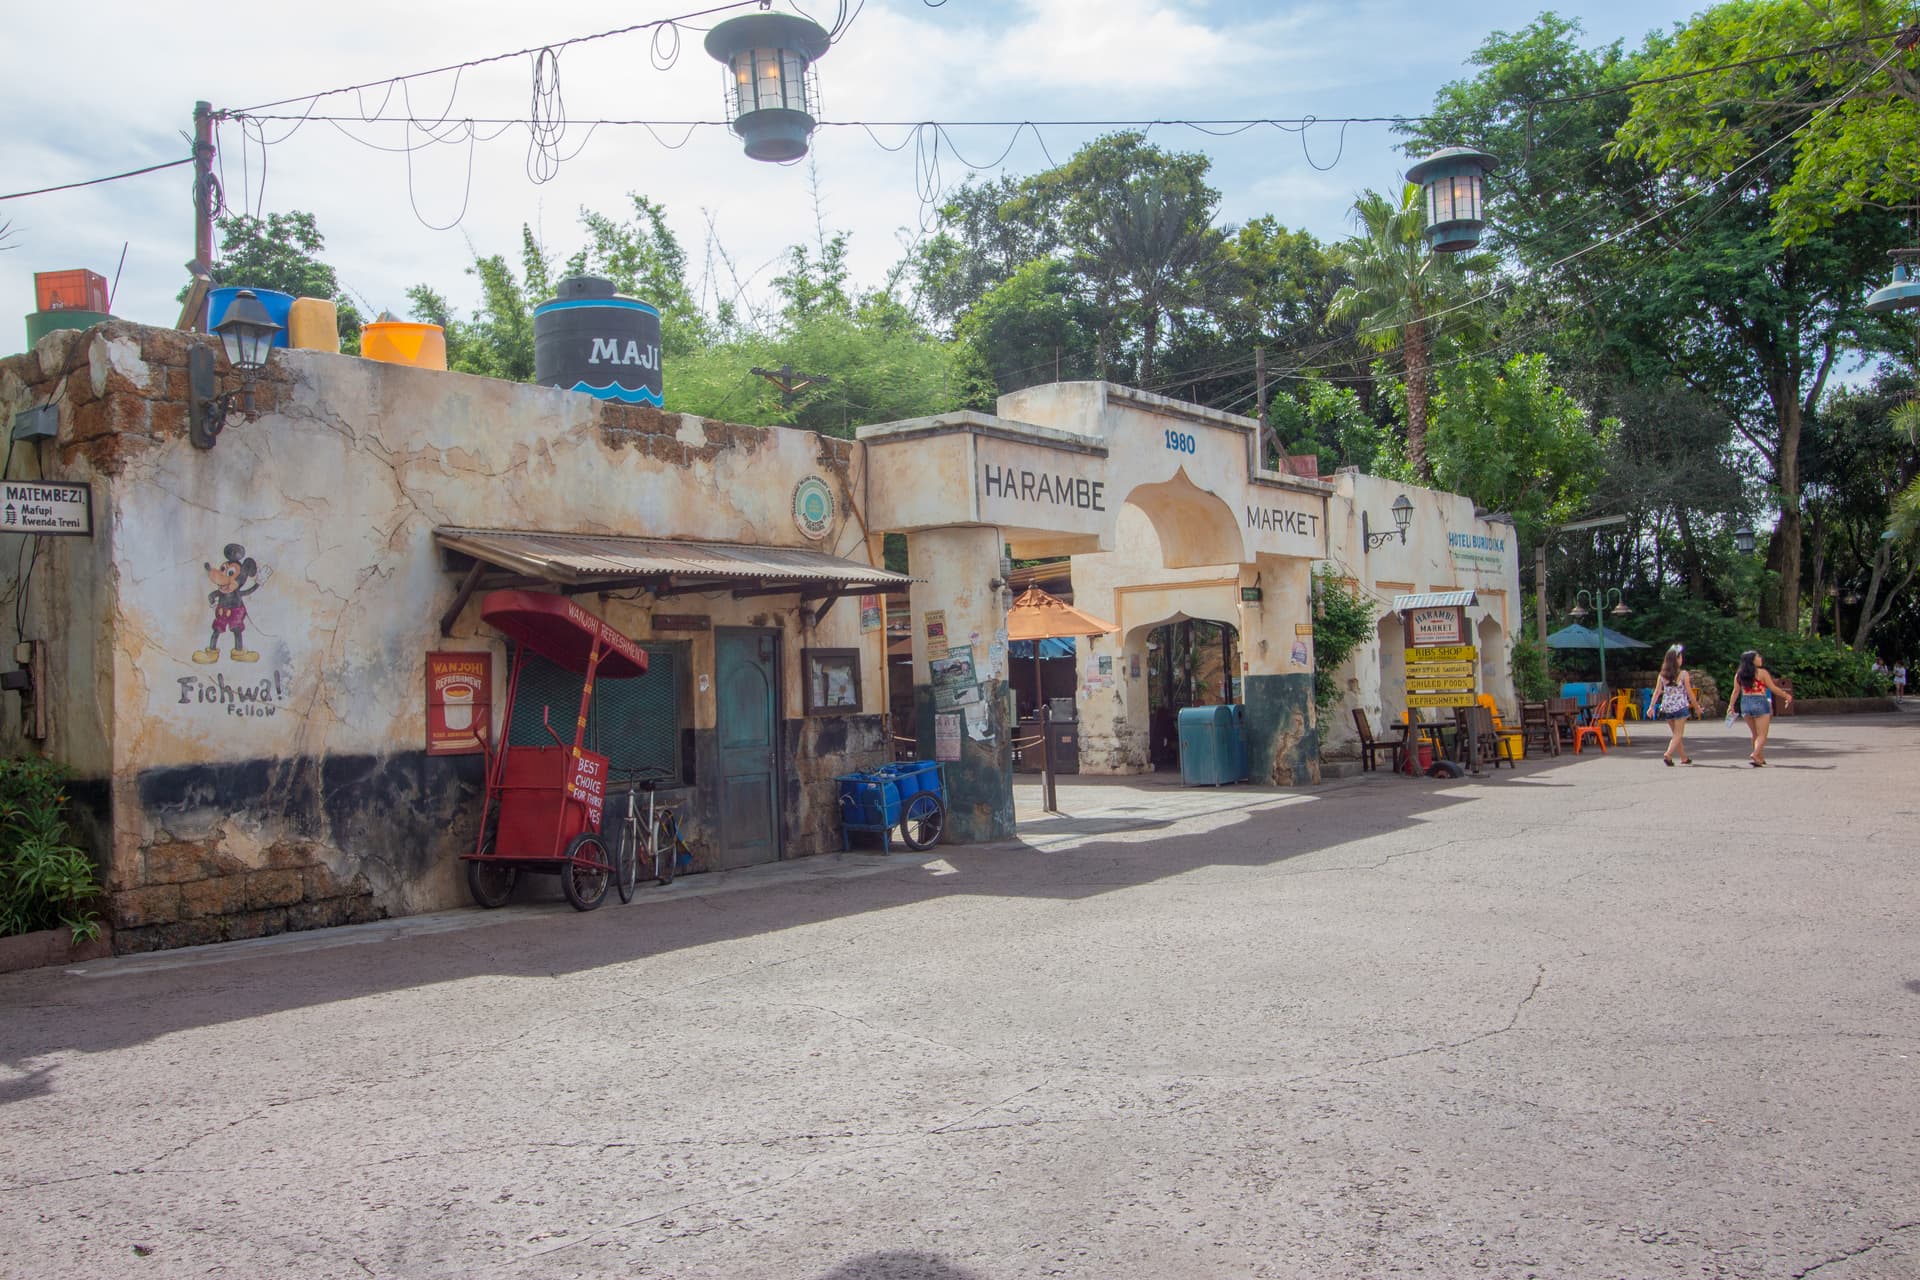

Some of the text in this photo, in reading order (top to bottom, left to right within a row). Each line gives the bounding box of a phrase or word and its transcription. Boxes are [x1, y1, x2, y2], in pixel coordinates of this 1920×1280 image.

[588, 337, 659, 371] MAJI
[1164, 428, 1196, 455] 1980
[985, 464, 1106, 512] HARAMBE
[21, 503, 53, 516] Mafupi
[22, 516, 80, 528] Kwenda Treni
[1246, 505, 1320, 538] MARKET
[568, 603, 645, 662] WANJOHI REFRESHMENT
[1420, 623, 1452, 632] MARKET
[1415, 647, 1462, 657] RIBS SHOP
[433, 663, 483, 675] WANJOHI
[177, 670, 282, 704] Fichwa!
[1443, 680, 1468, 688] FOODS
[227, 703, 276, 717] Fellow
[577, 757, 600, 776] BEST
[575, 774, 602, 794] CHOICE
[573, 787, 587, 801] FOR
[588, 807, 601, 825] YES
